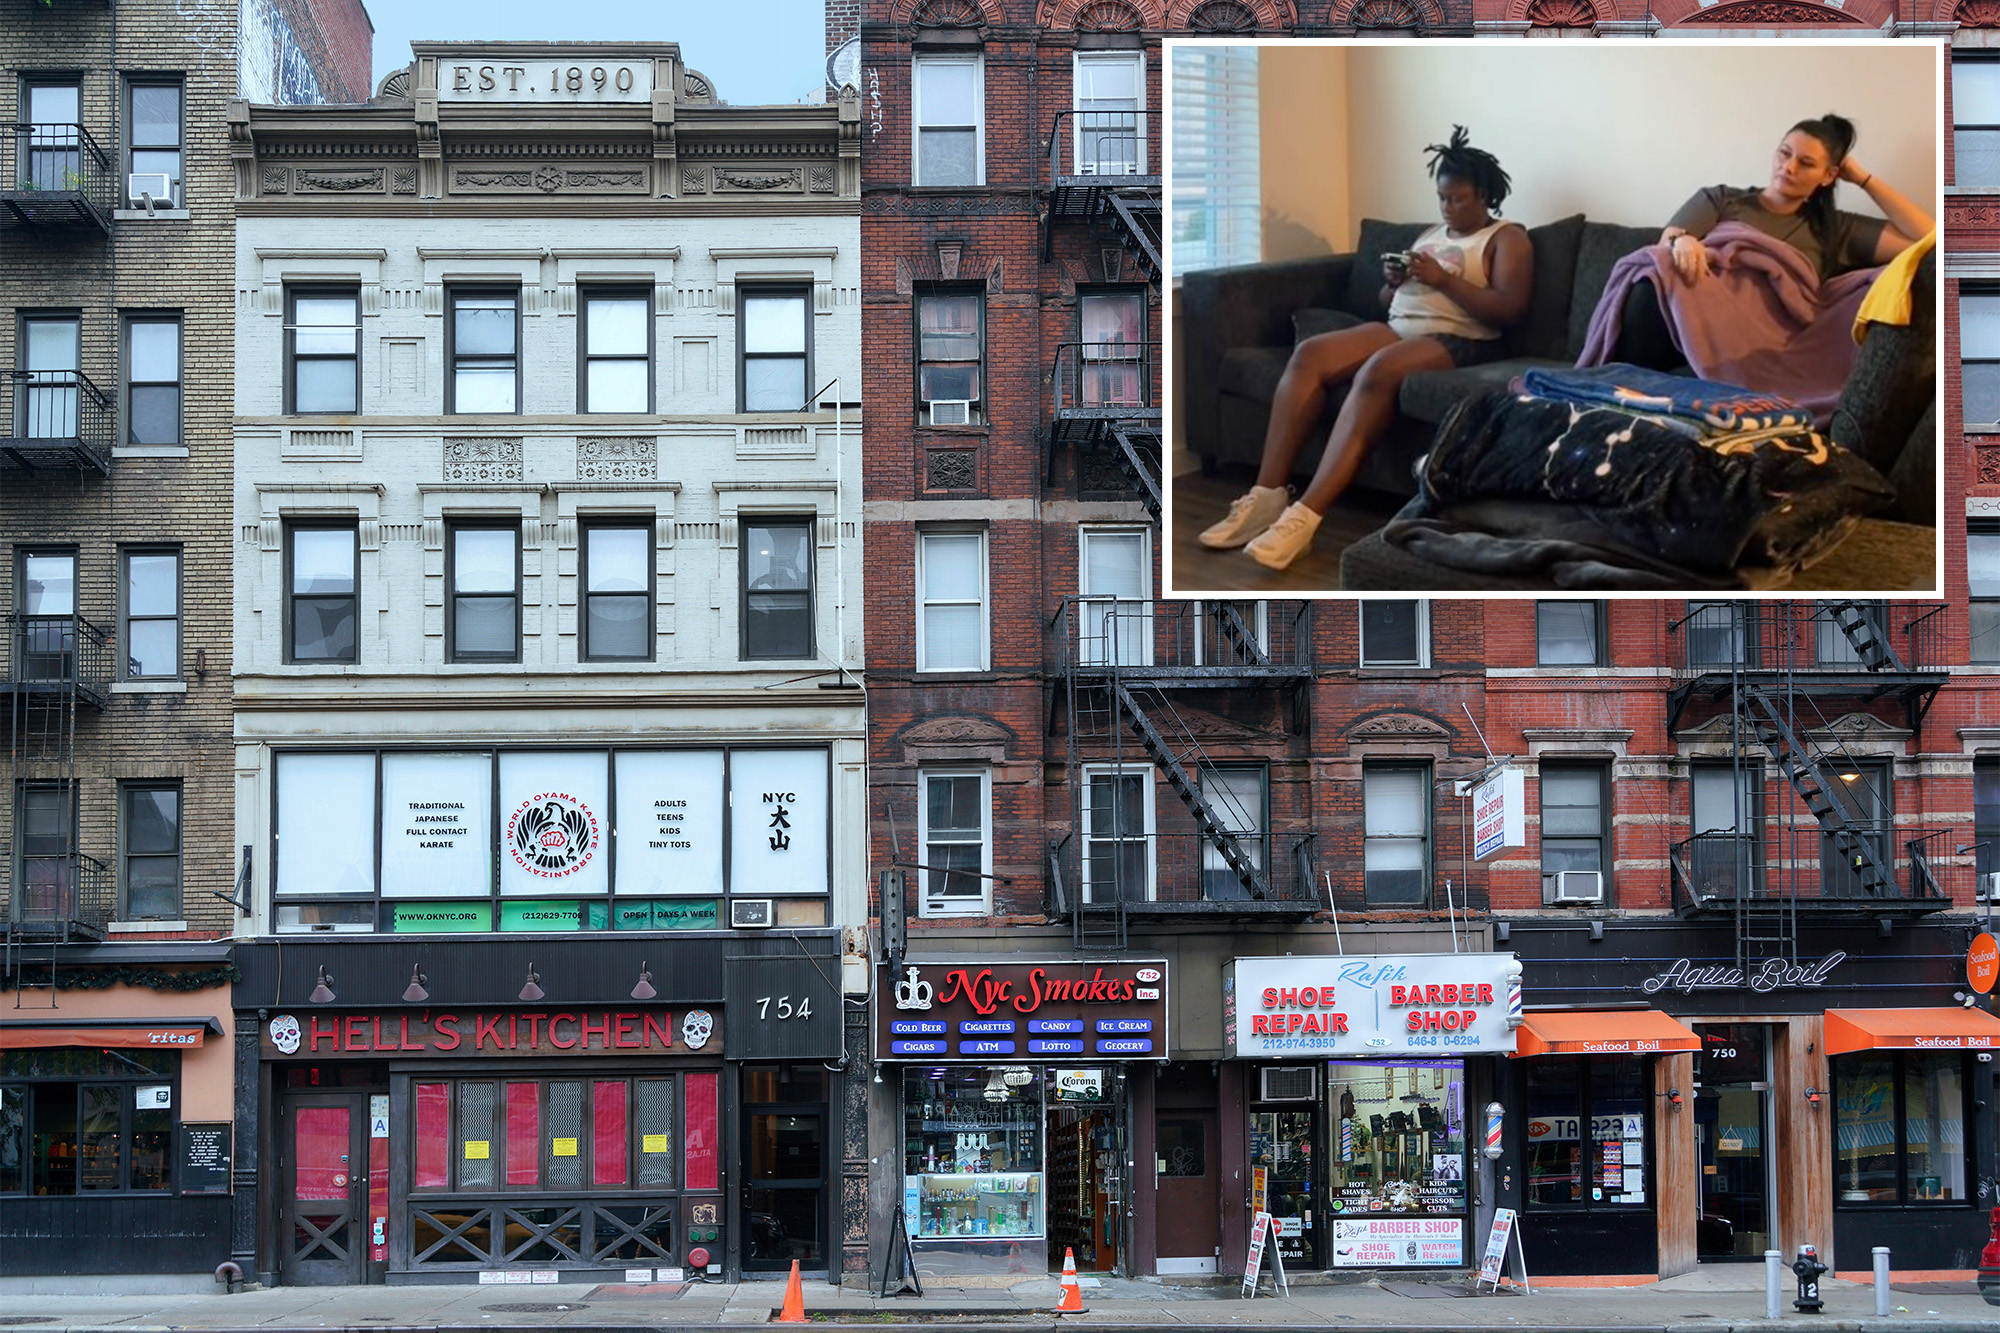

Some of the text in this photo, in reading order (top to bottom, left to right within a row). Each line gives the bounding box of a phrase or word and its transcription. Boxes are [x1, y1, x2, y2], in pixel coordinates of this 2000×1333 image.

[452, 66, 634, 92] EST. 1890
[762, 792, 796, 803] NYC
[1477, 795, 1503, 822] SHOE REPAIR
[768, 804, 791, 851] 大山
[1477, 816, 1504, 844] BARBER SHOP
[507, 792, 599, 878] WORLD OYAMA KARATE ORGANIZATION
[399, 912, 477, 921] WWW.OKNYC.ORG
[623, 911, 647, 920] OPEN
[657, 910, 680, 919] DAYS
[682, 910, 688, 919] A
[690, 909, 716, 918] WEEK
[1970, 948, 1996, 964] Seafood
[1139, 971, 1158, 980] 752
[1337, 961, 1408, 989] Rafik
[1643, 951, 1847, 994] Aqua Boil
[1976, 964, 1991, 977] Boil
[938, 968, 1135, 1015] Nyc Smokes
[1139, 989, 1157, 999] Inc.
[1262, 986, 1336, 1008] SHOE
[1390, 983, 1494, 1006] BARBER
[757, 996, 812, 1020] 754
[964, 1022, 1011, 1031] CIGARETTES
[1040, 1022, 1071, 1031] CANDY
[1100, 1022, 1148, 1031] ICE CREAM
[1251, 1012, 1349, 1034] REPAIR
[1406, 1010, 1478, 1032] SHOP
[310, 1008, 673, 1051] HELL'S KITCHEN
[896, 1024, 942, 1032] COLD BEER
[147, 1032, 196, 1044] 'ritas
[1262, 1037, 1335, 1049] 212-974-3950
[1371, 1038, 1385, 1046] 752
[1407, 1035, 1480, 1047] 646-80-6294
[1914, 1036, 1991, 1047] Seafood Boil
[903, 1042, 935, 1051] CIGARS
[976, 1042, 999, 1051] ATM
[1041, 1041, 1071, 1050] LOTTO
[1583, 1040, 1660, 1052] Seafood Boil
[1712, 1048, 1737, 1058] 750
[1062, 1076, 1097, 1088] Corona
[374, 1119, 386, 1132] A
[1626, 1119, 1638, 1132] A
[1370, 1222, 1420, 1234] BARBER
[1425, 1221, 1459, 1233] SHOP
[1362, 1243, 1390, 1251] SHOE
[1421, 1243, 1456, 1251] WATCH
[1357, 1252, 1396, 1260] REPAIR
[1423, 1251, 1458, 1259] REPAIR
